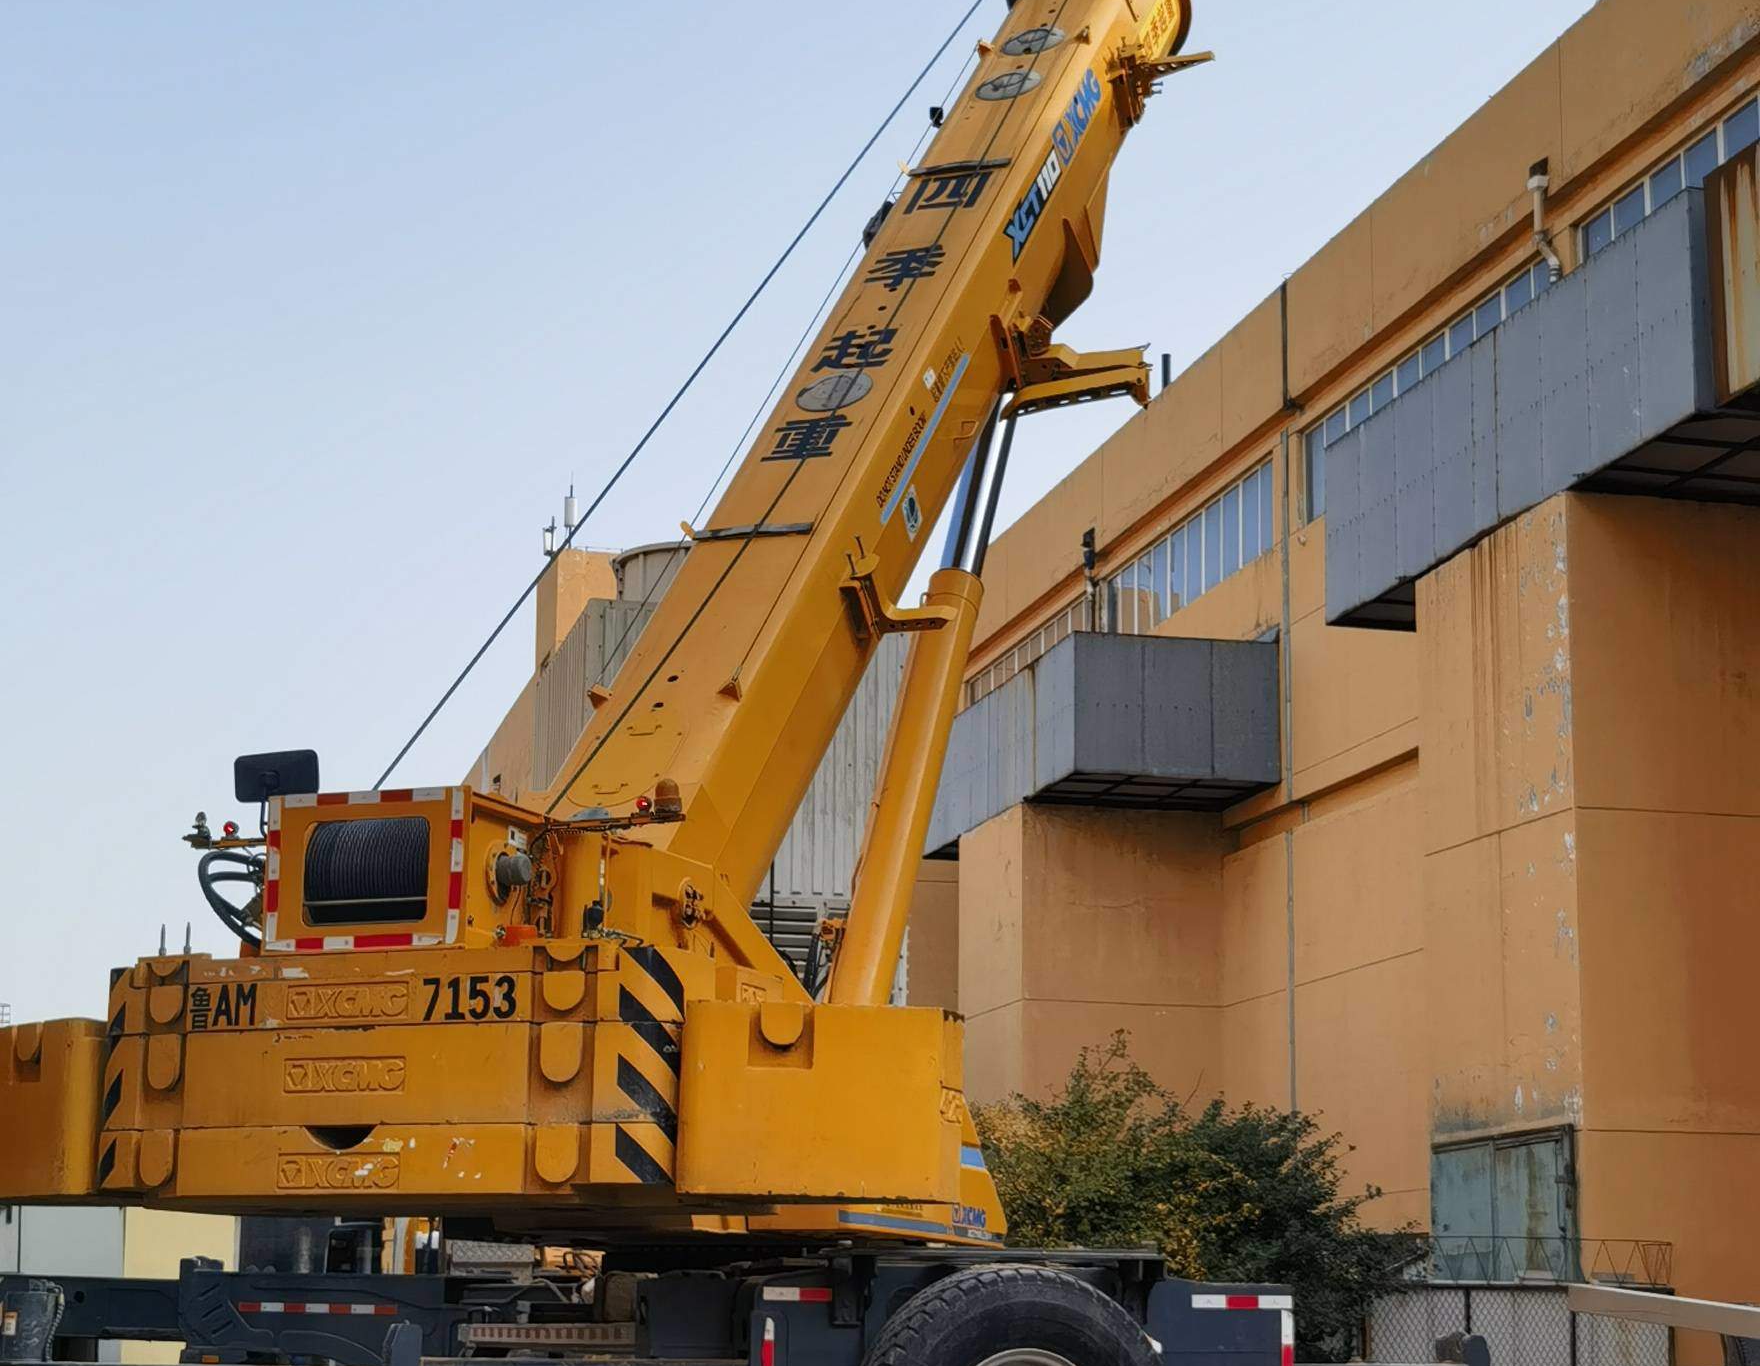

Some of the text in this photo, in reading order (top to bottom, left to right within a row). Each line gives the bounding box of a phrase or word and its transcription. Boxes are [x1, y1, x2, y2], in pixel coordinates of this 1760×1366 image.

[1003, 67, 1101, 264] XCT110 XCMG
[313, 984, 407, 1019] XCMG
[422, 975, 518, 1022] 7153
[308, 1057, 404, 1092] XCMG
[300, 1154, 398, 1189] XCMG
[962, 1206, 986, 1228] XCMG
